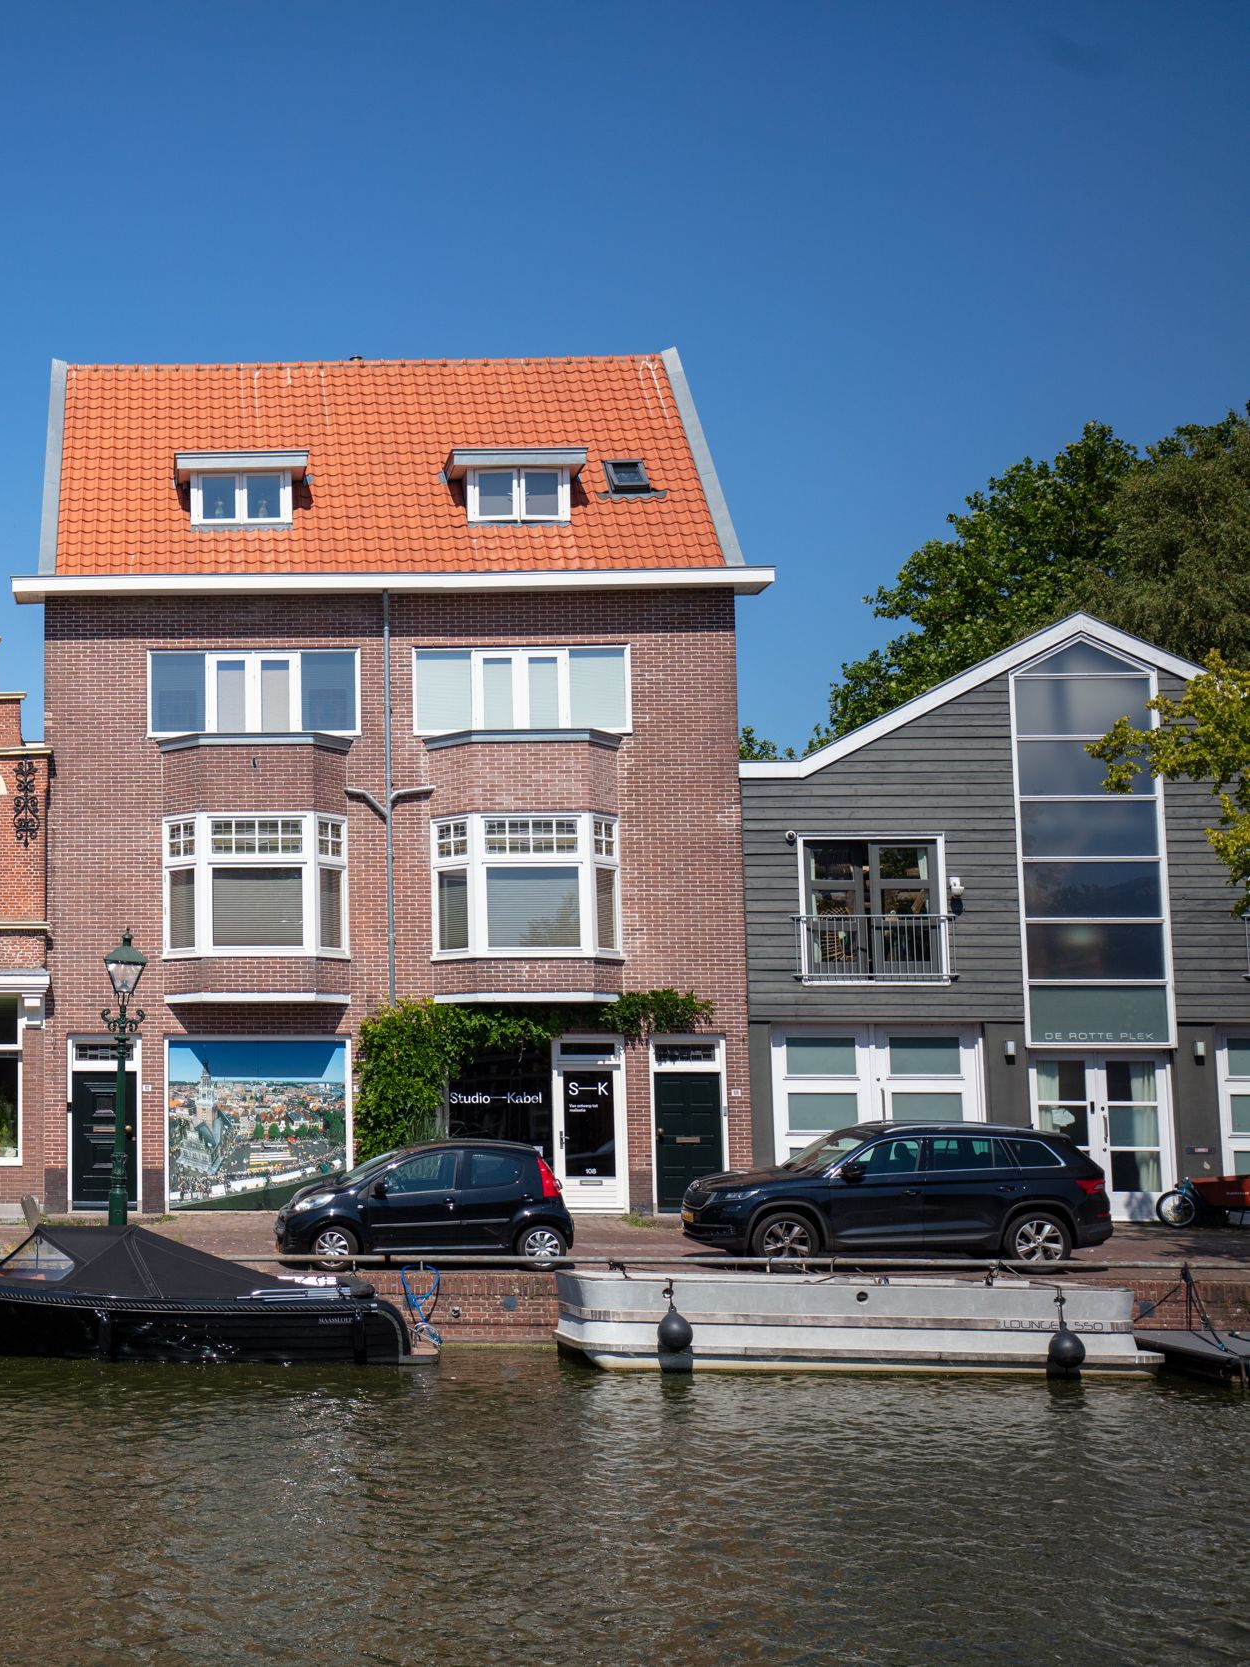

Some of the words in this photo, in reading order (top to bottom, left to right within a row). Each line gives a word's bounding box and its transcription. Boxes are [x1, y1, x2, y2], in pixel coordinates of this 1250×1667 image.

[1044, 1032, 1062, 1040] DE
[1069, 1032, 1113, 1040] ROTTE
[1120, 1032, 1154, 1040] PLEK
[585, 1167, 597, 1175] 108
[1003, 1320, 1062, 1330] LOUNGE
[1074, 1321, 1104, 1331] 550
